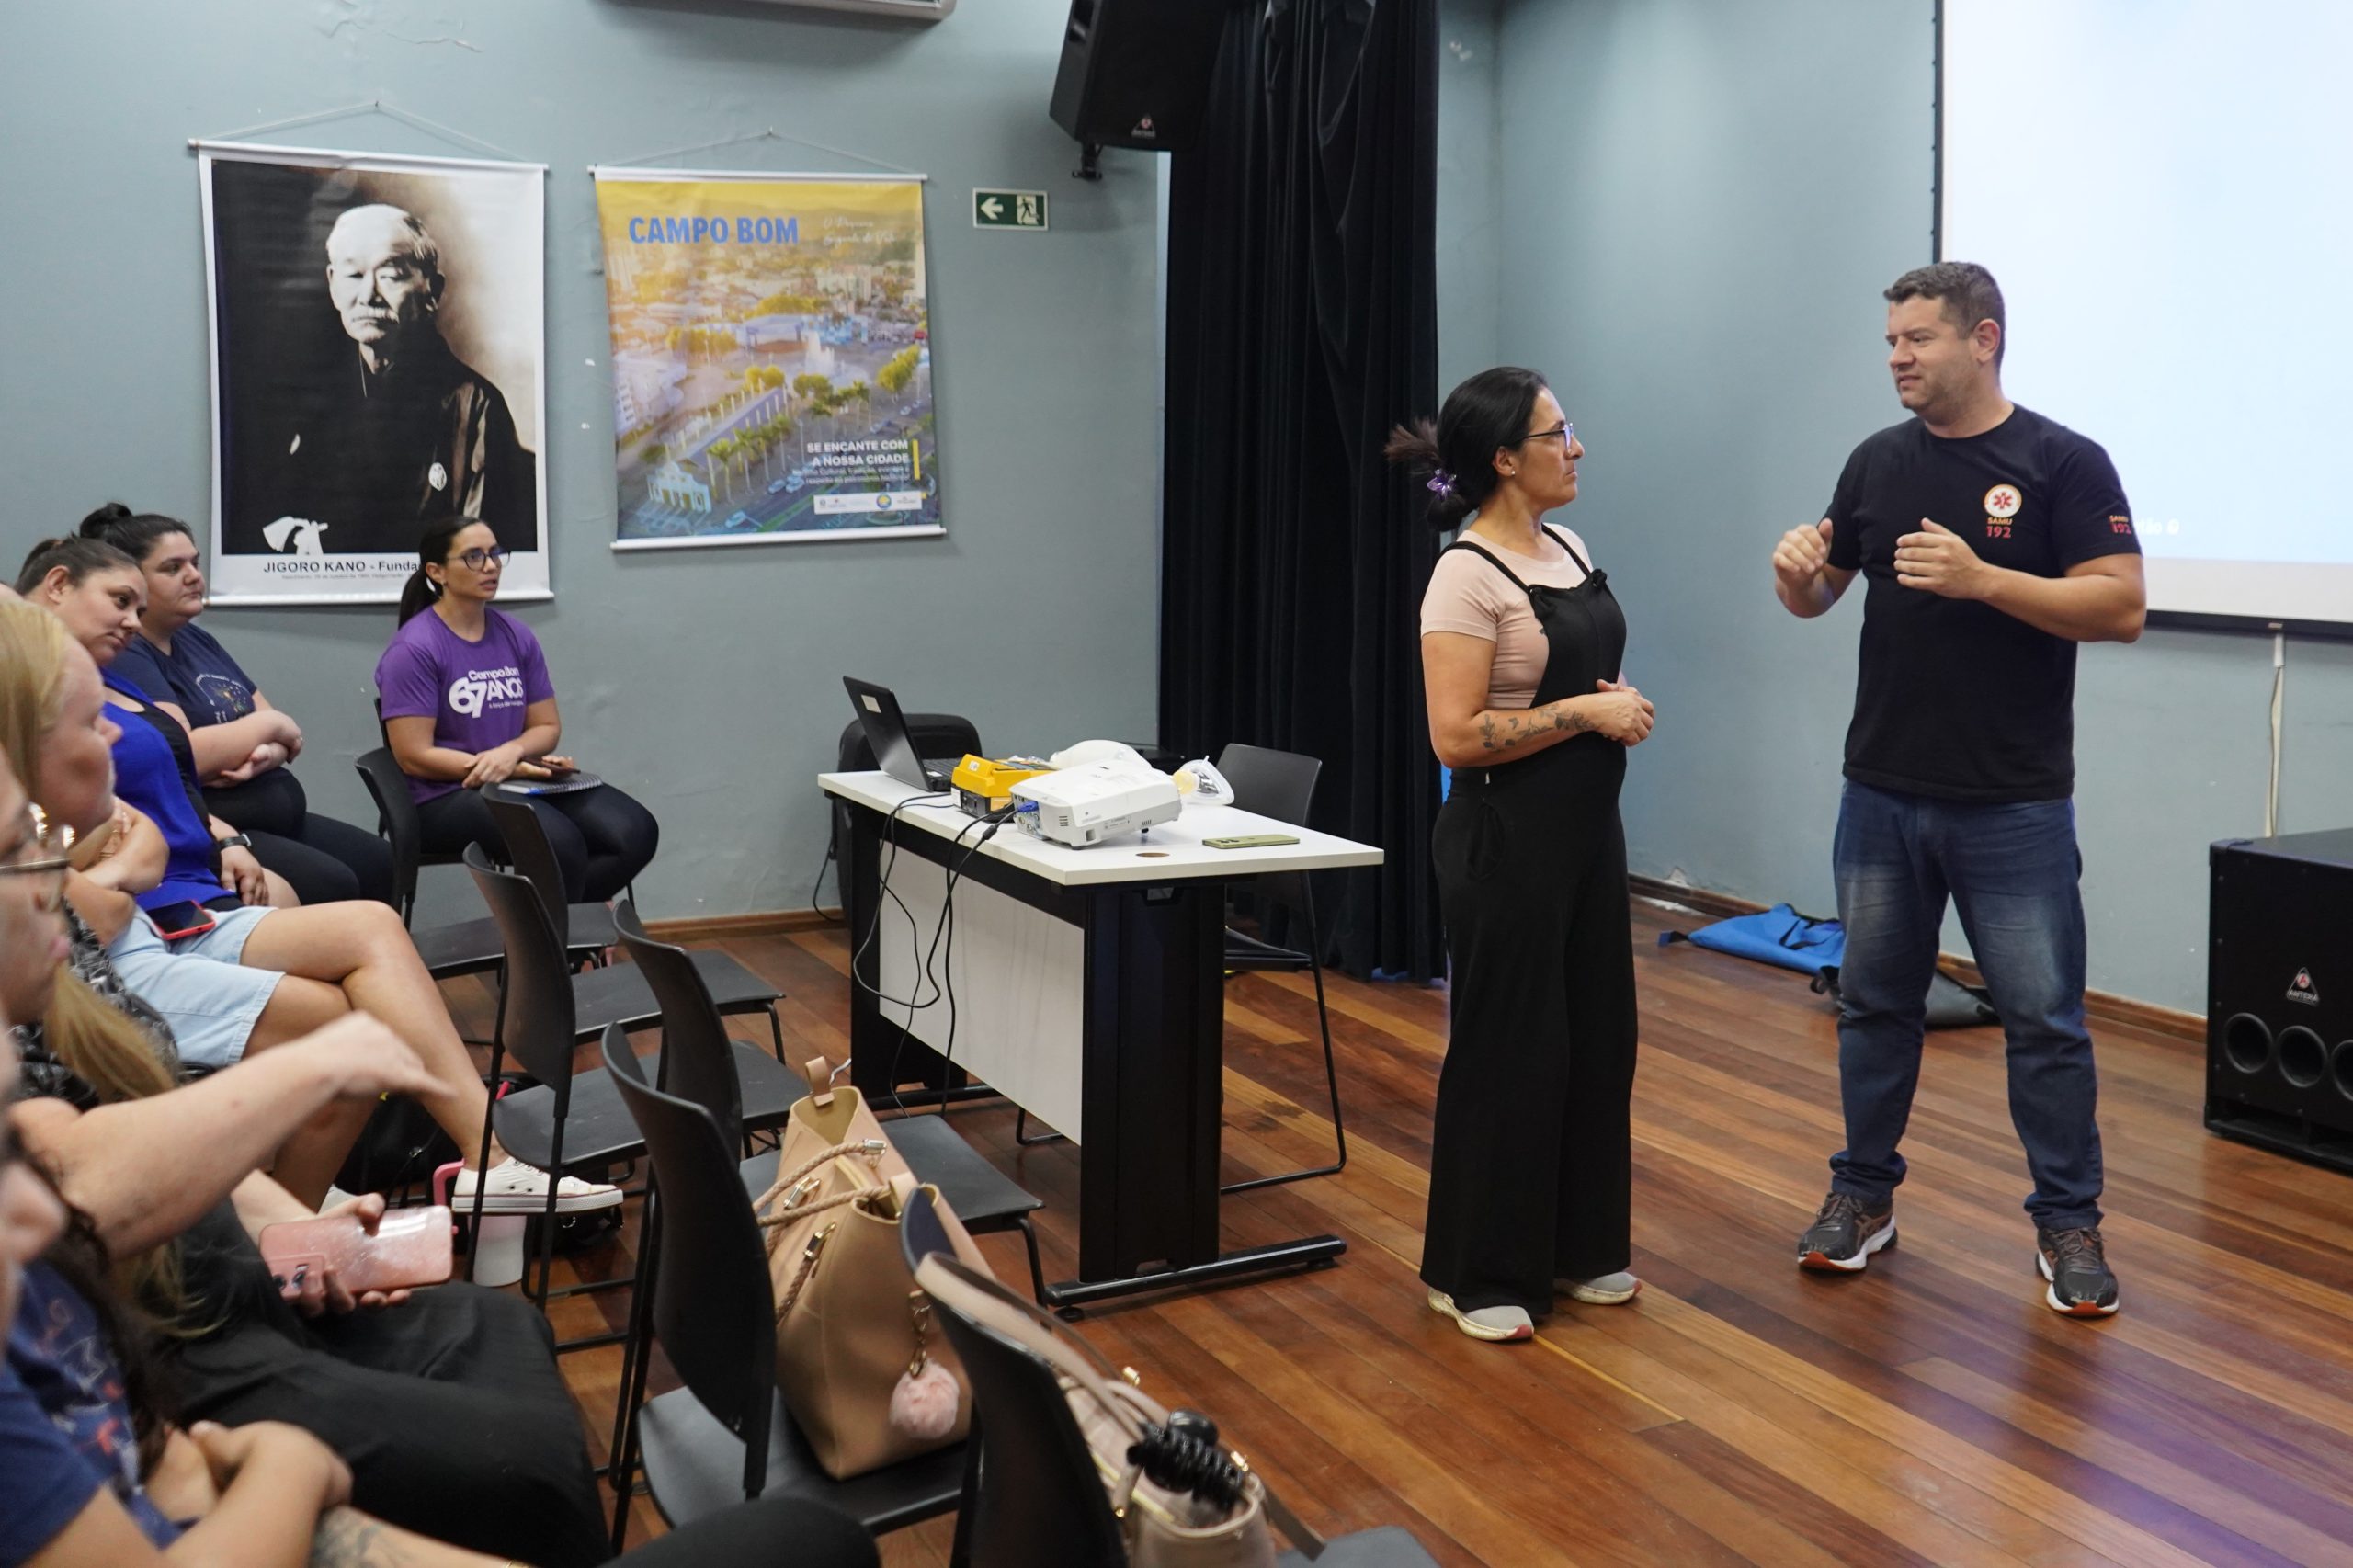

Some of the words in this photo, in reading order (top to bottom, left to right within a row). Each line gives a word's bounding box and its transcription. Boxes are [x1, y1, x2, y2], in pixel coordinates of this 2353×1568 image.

[629, 216, 730, 244] CAMPO
[735, 216, 799, 244] BOM
[807, 442, 822, 453] SE
[824, 440, 880, 453] ENCANTE
[881, 439, 908, 451] COM
[812, 457, 821, 467] A
[823, 456, 864, 467] NOSSA
[866, 453, 909, 465] CIDADE
[1987, 517, 2013, 525] SAMU
[1986, 526, 2011, 539] 192
[263, 561, 320, 573] JIGORO
[324, 561, 366, 573] KANO
[468, 668, 505, 681] Campo
[449, 676, 487, 718] 67
